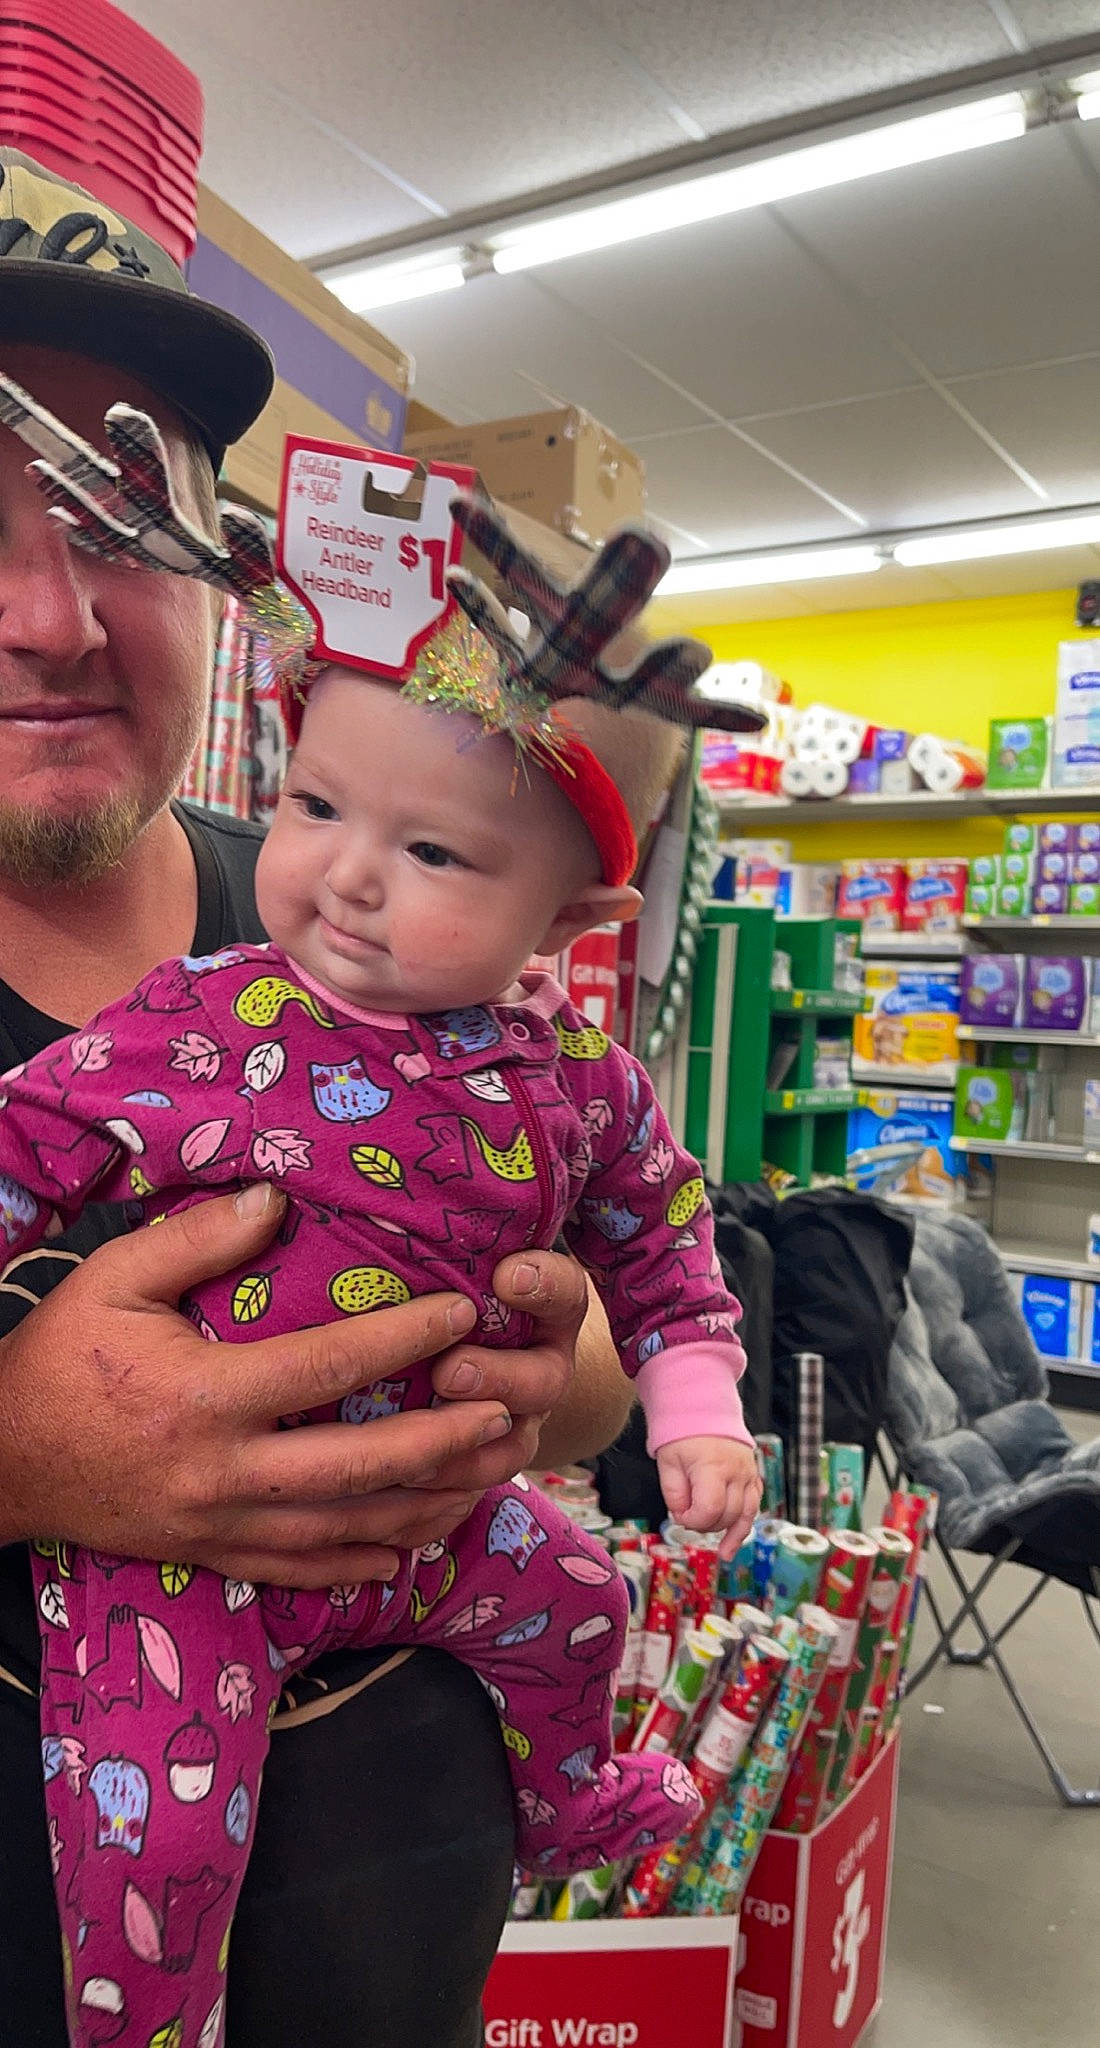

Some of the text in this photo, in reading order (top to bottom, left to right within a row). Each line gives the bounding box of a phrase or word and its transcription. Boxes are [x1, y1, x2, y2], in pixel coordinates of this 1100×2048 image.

[307, 516, 386, 551] Reindeer
[320, 547, 374, 577] Antler
[398, 531, 447, 601] $1
[301, 569, 393, 609] Headband
[743, 1896, 791, 1928] rap
[484, 2017, 639, 2048] Gift Wrap
